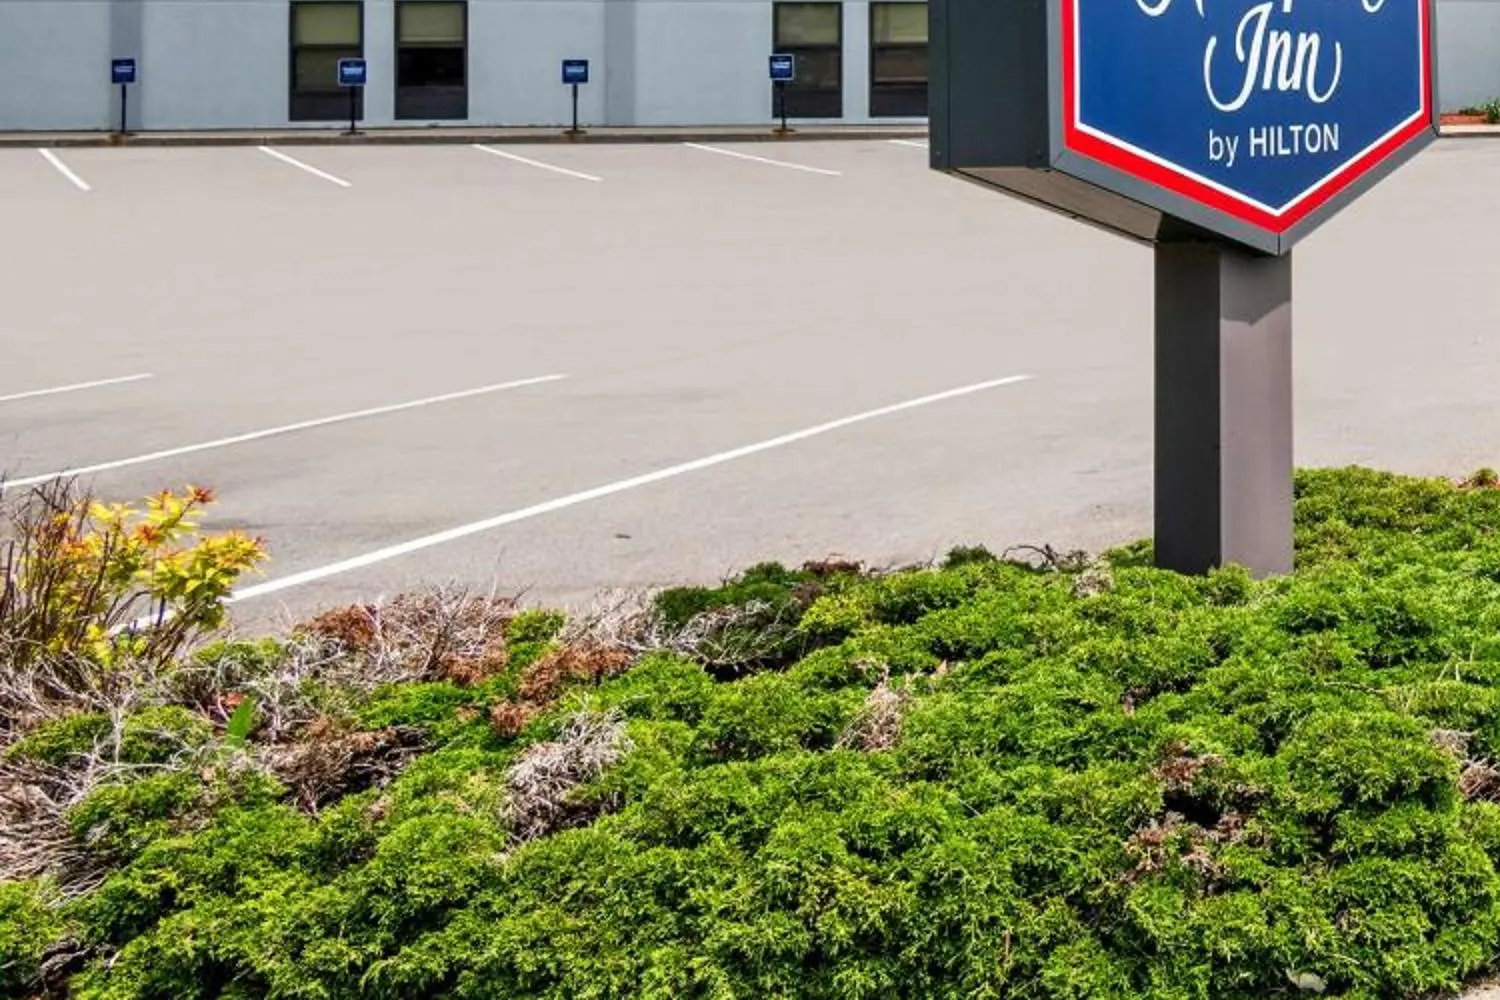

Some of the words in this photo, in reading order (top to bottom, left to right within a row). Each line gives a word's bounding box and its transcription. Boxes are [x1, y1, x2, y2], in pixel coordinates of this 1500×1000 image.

[1204, 1, 1342, 111] Inn
[1209, 129, 1239, 168] by
[1249, 123, 1339, 157] HILTON
